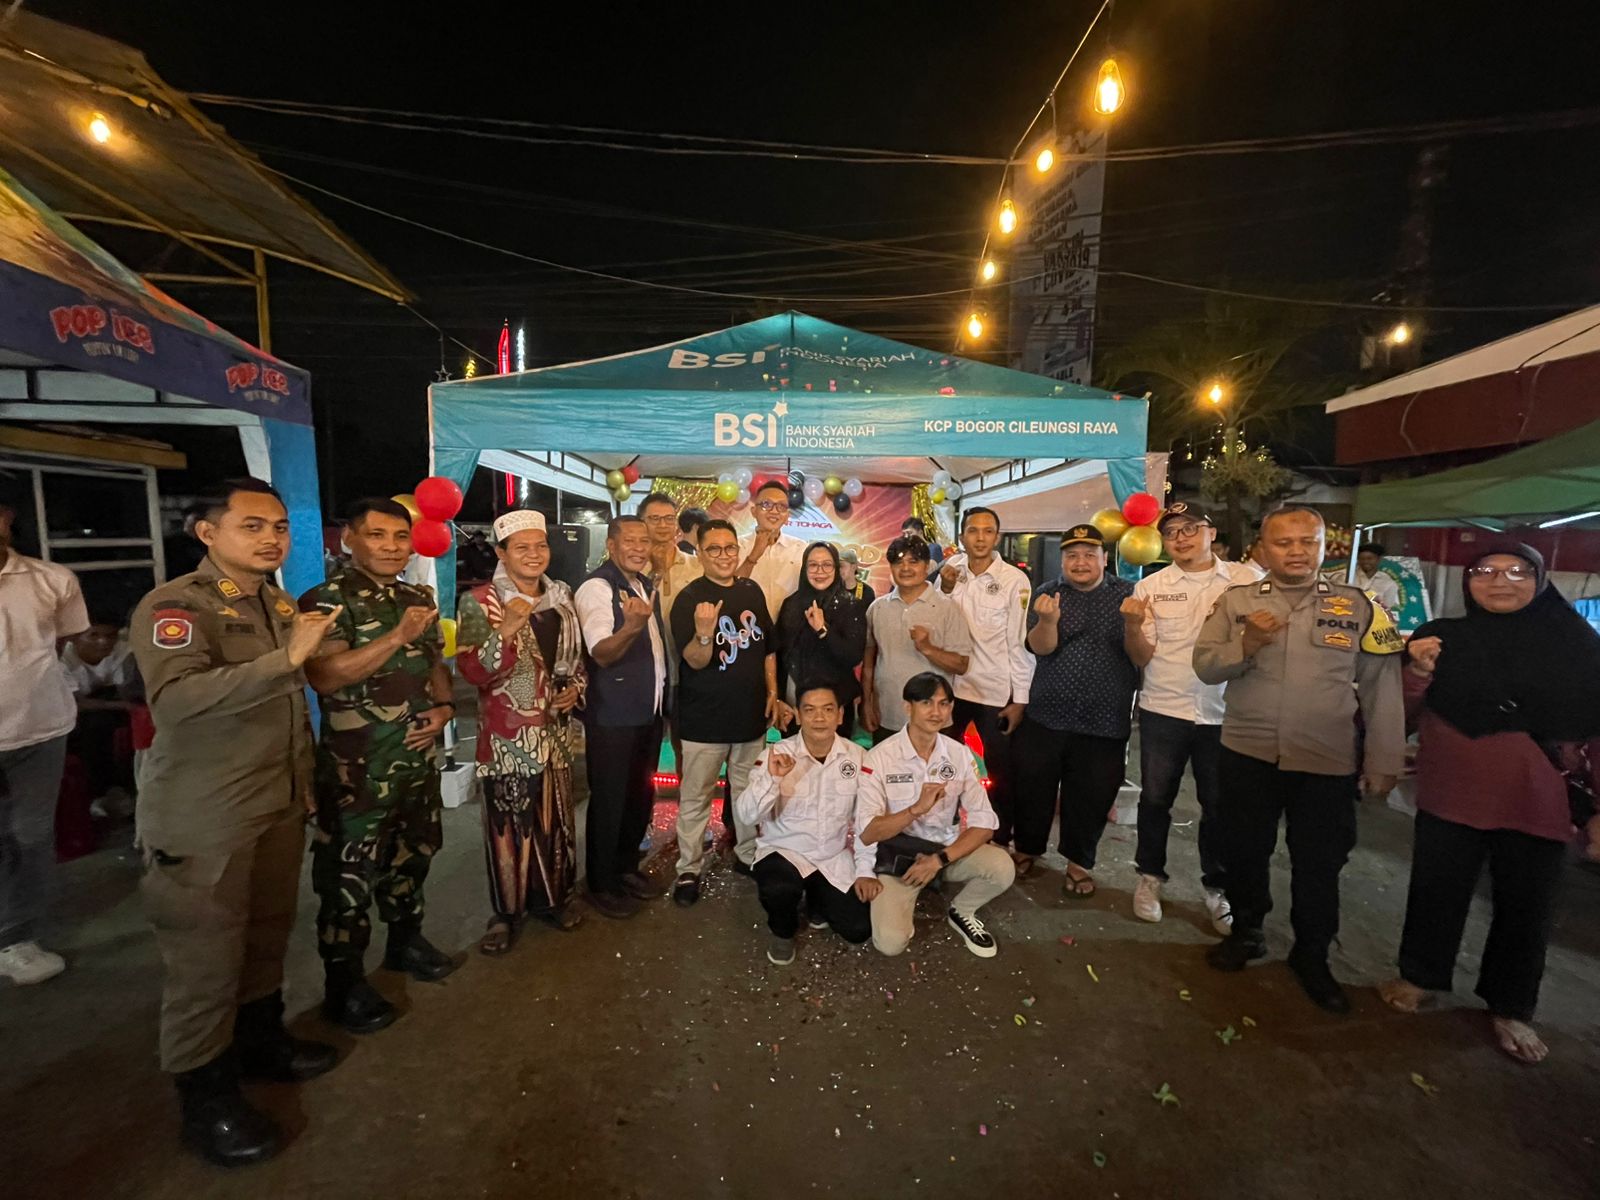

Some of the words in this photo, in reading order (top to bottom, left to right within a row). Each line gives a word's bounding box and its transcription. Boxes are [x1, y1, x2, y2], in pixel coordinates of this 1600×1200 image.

[50, 305, 107, 343] POP
[668, 348, 766, 369] BSI
[226, 363, 259, 393] POP
[713, 412, 778, 448] BSI
[785, 425, 821, 436] BANK
[823, 425, 876, 437] SYARIAH
[924, 420, 952, 433] KCP
[955, 420, 1006, 433] BOGOR
[1008, 421, 1080, 434] CILEUNGSI
[1083, 422, 1119, 435] RAYA
[785, 437, 855, 449] INDONESIA
[796, 521, 832, 529] TOHAGA
[1317, 619, 1360, 632] POLRI
